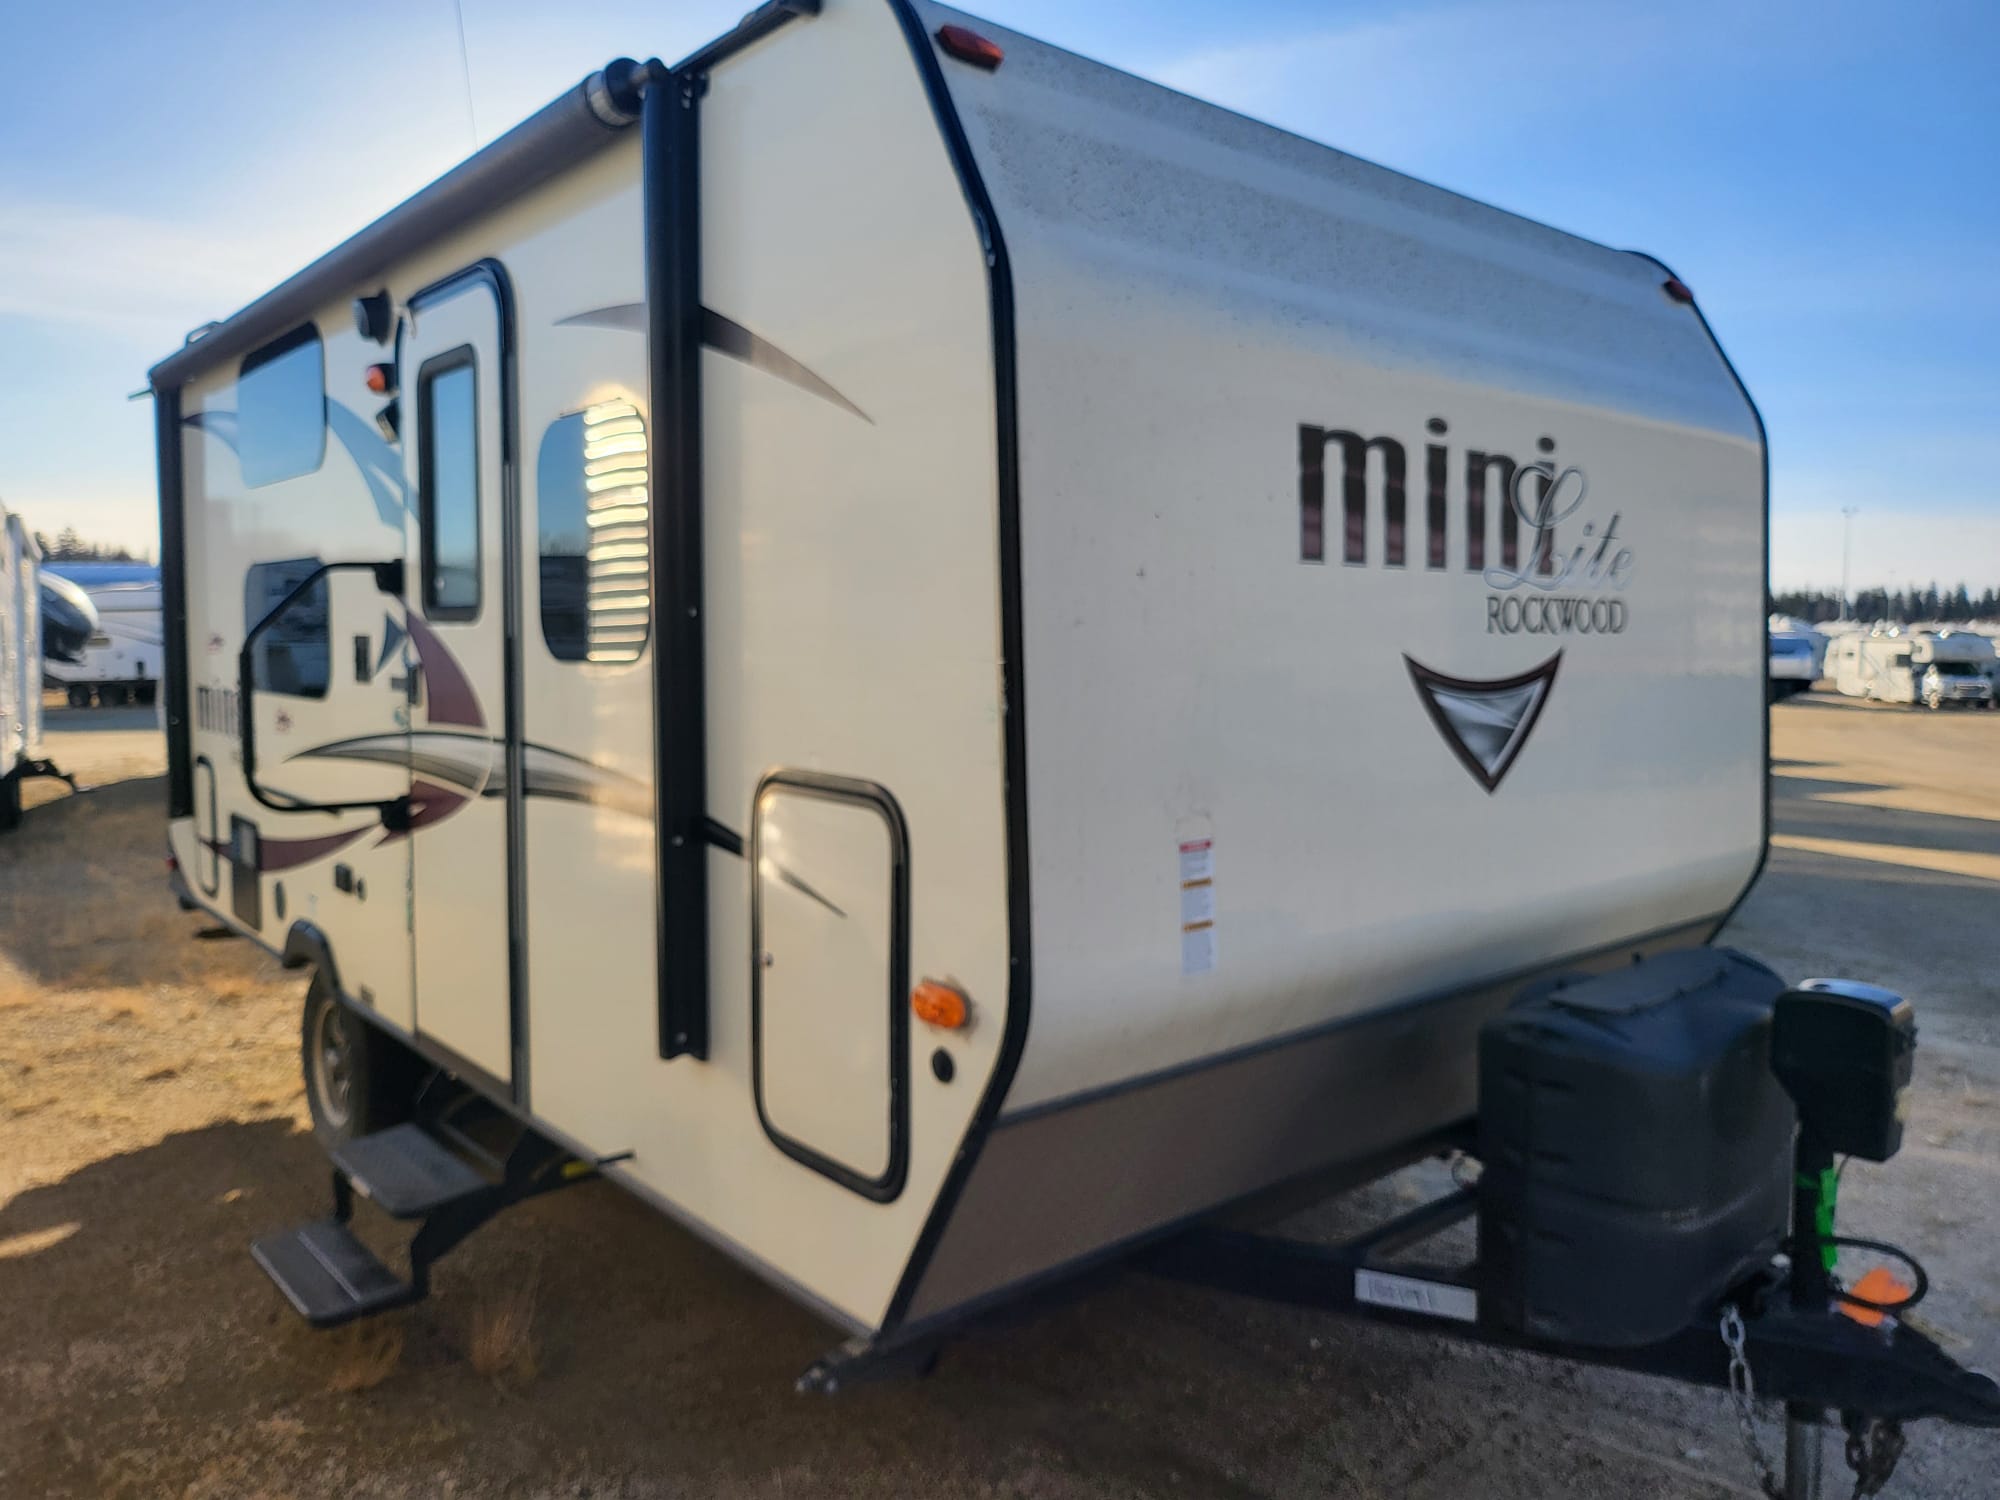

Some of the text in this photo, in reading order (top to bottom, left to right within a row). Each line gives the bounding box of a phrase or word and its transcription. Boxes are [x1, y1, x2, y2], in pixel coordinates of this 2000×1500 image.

[1298, 417, 1634, 591] mini Lite
[1486, 596, 1628, 635] ROCKWOOD
